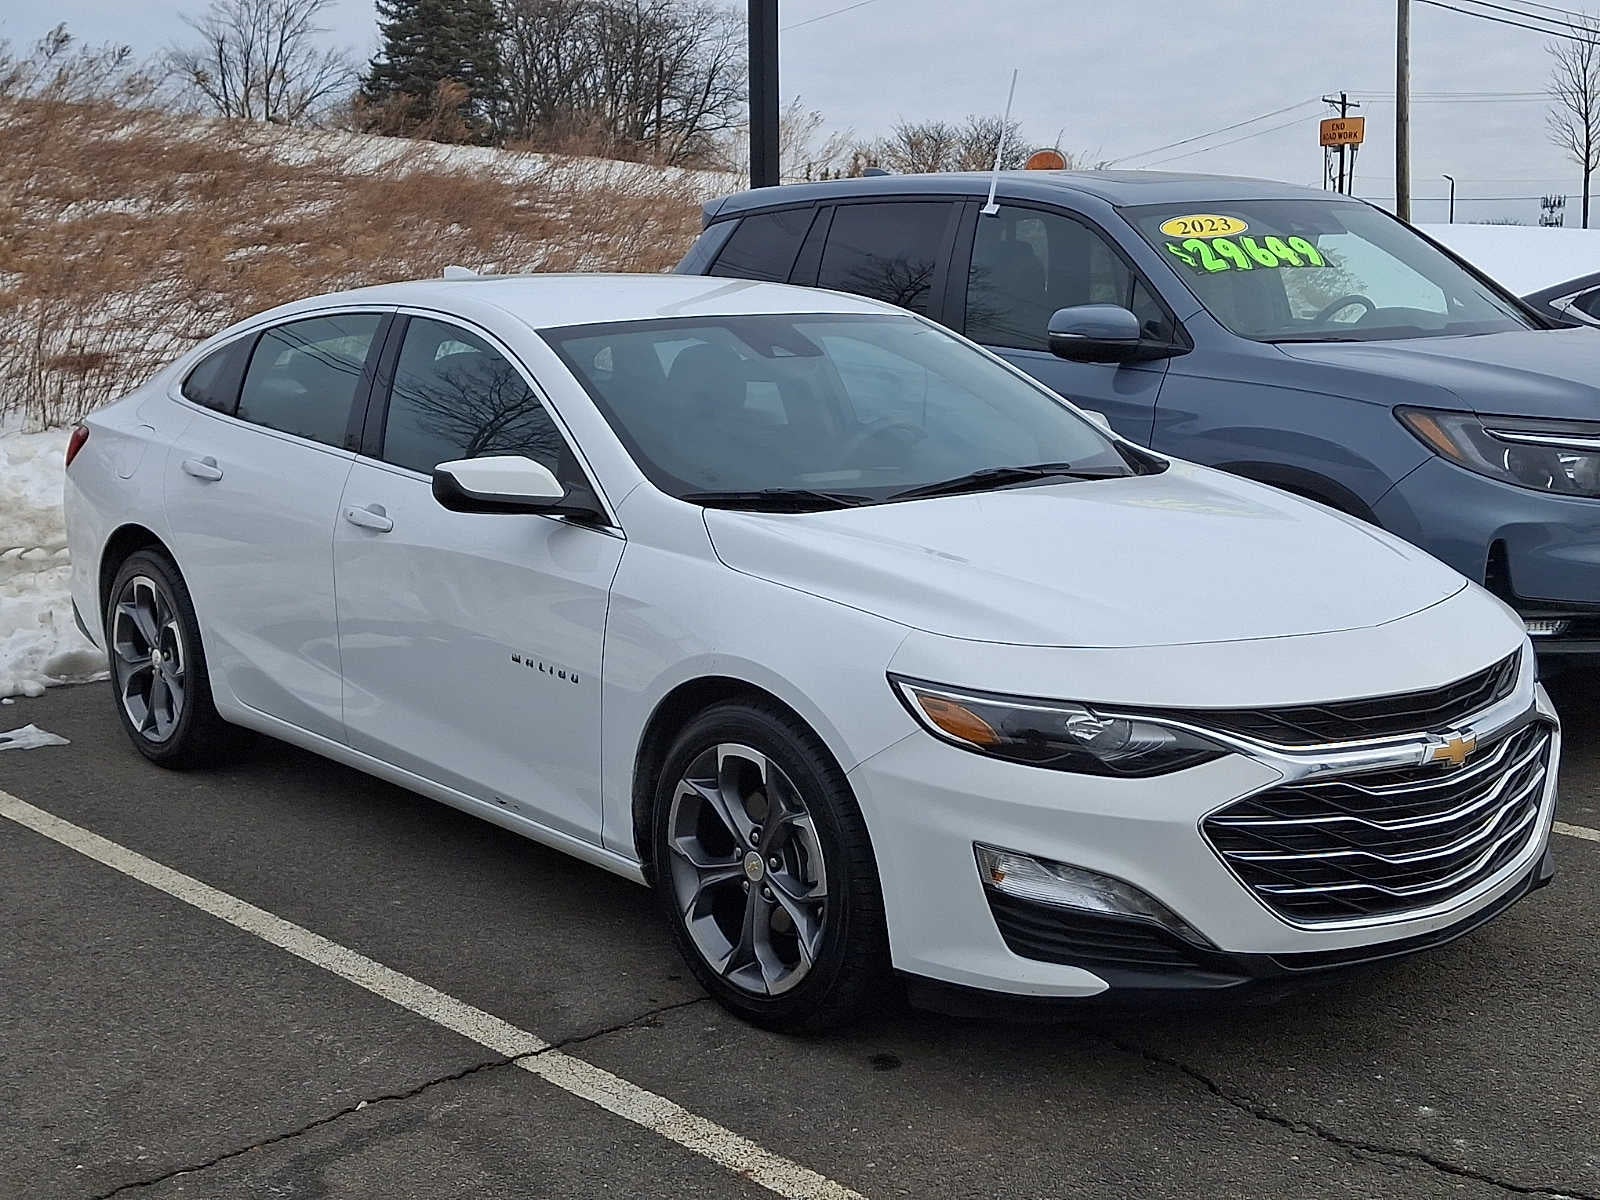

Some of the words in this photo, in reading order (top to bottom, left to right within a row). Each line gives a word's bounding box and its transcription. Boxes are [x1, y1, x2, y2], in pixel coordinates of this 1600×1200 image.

[1331, 122, 1345, 131] END
[1337, 131, 1358, 139] WORK
[1177, 217, 1231, 235] 2023
[511, 653, 579, 684] MALIBU
